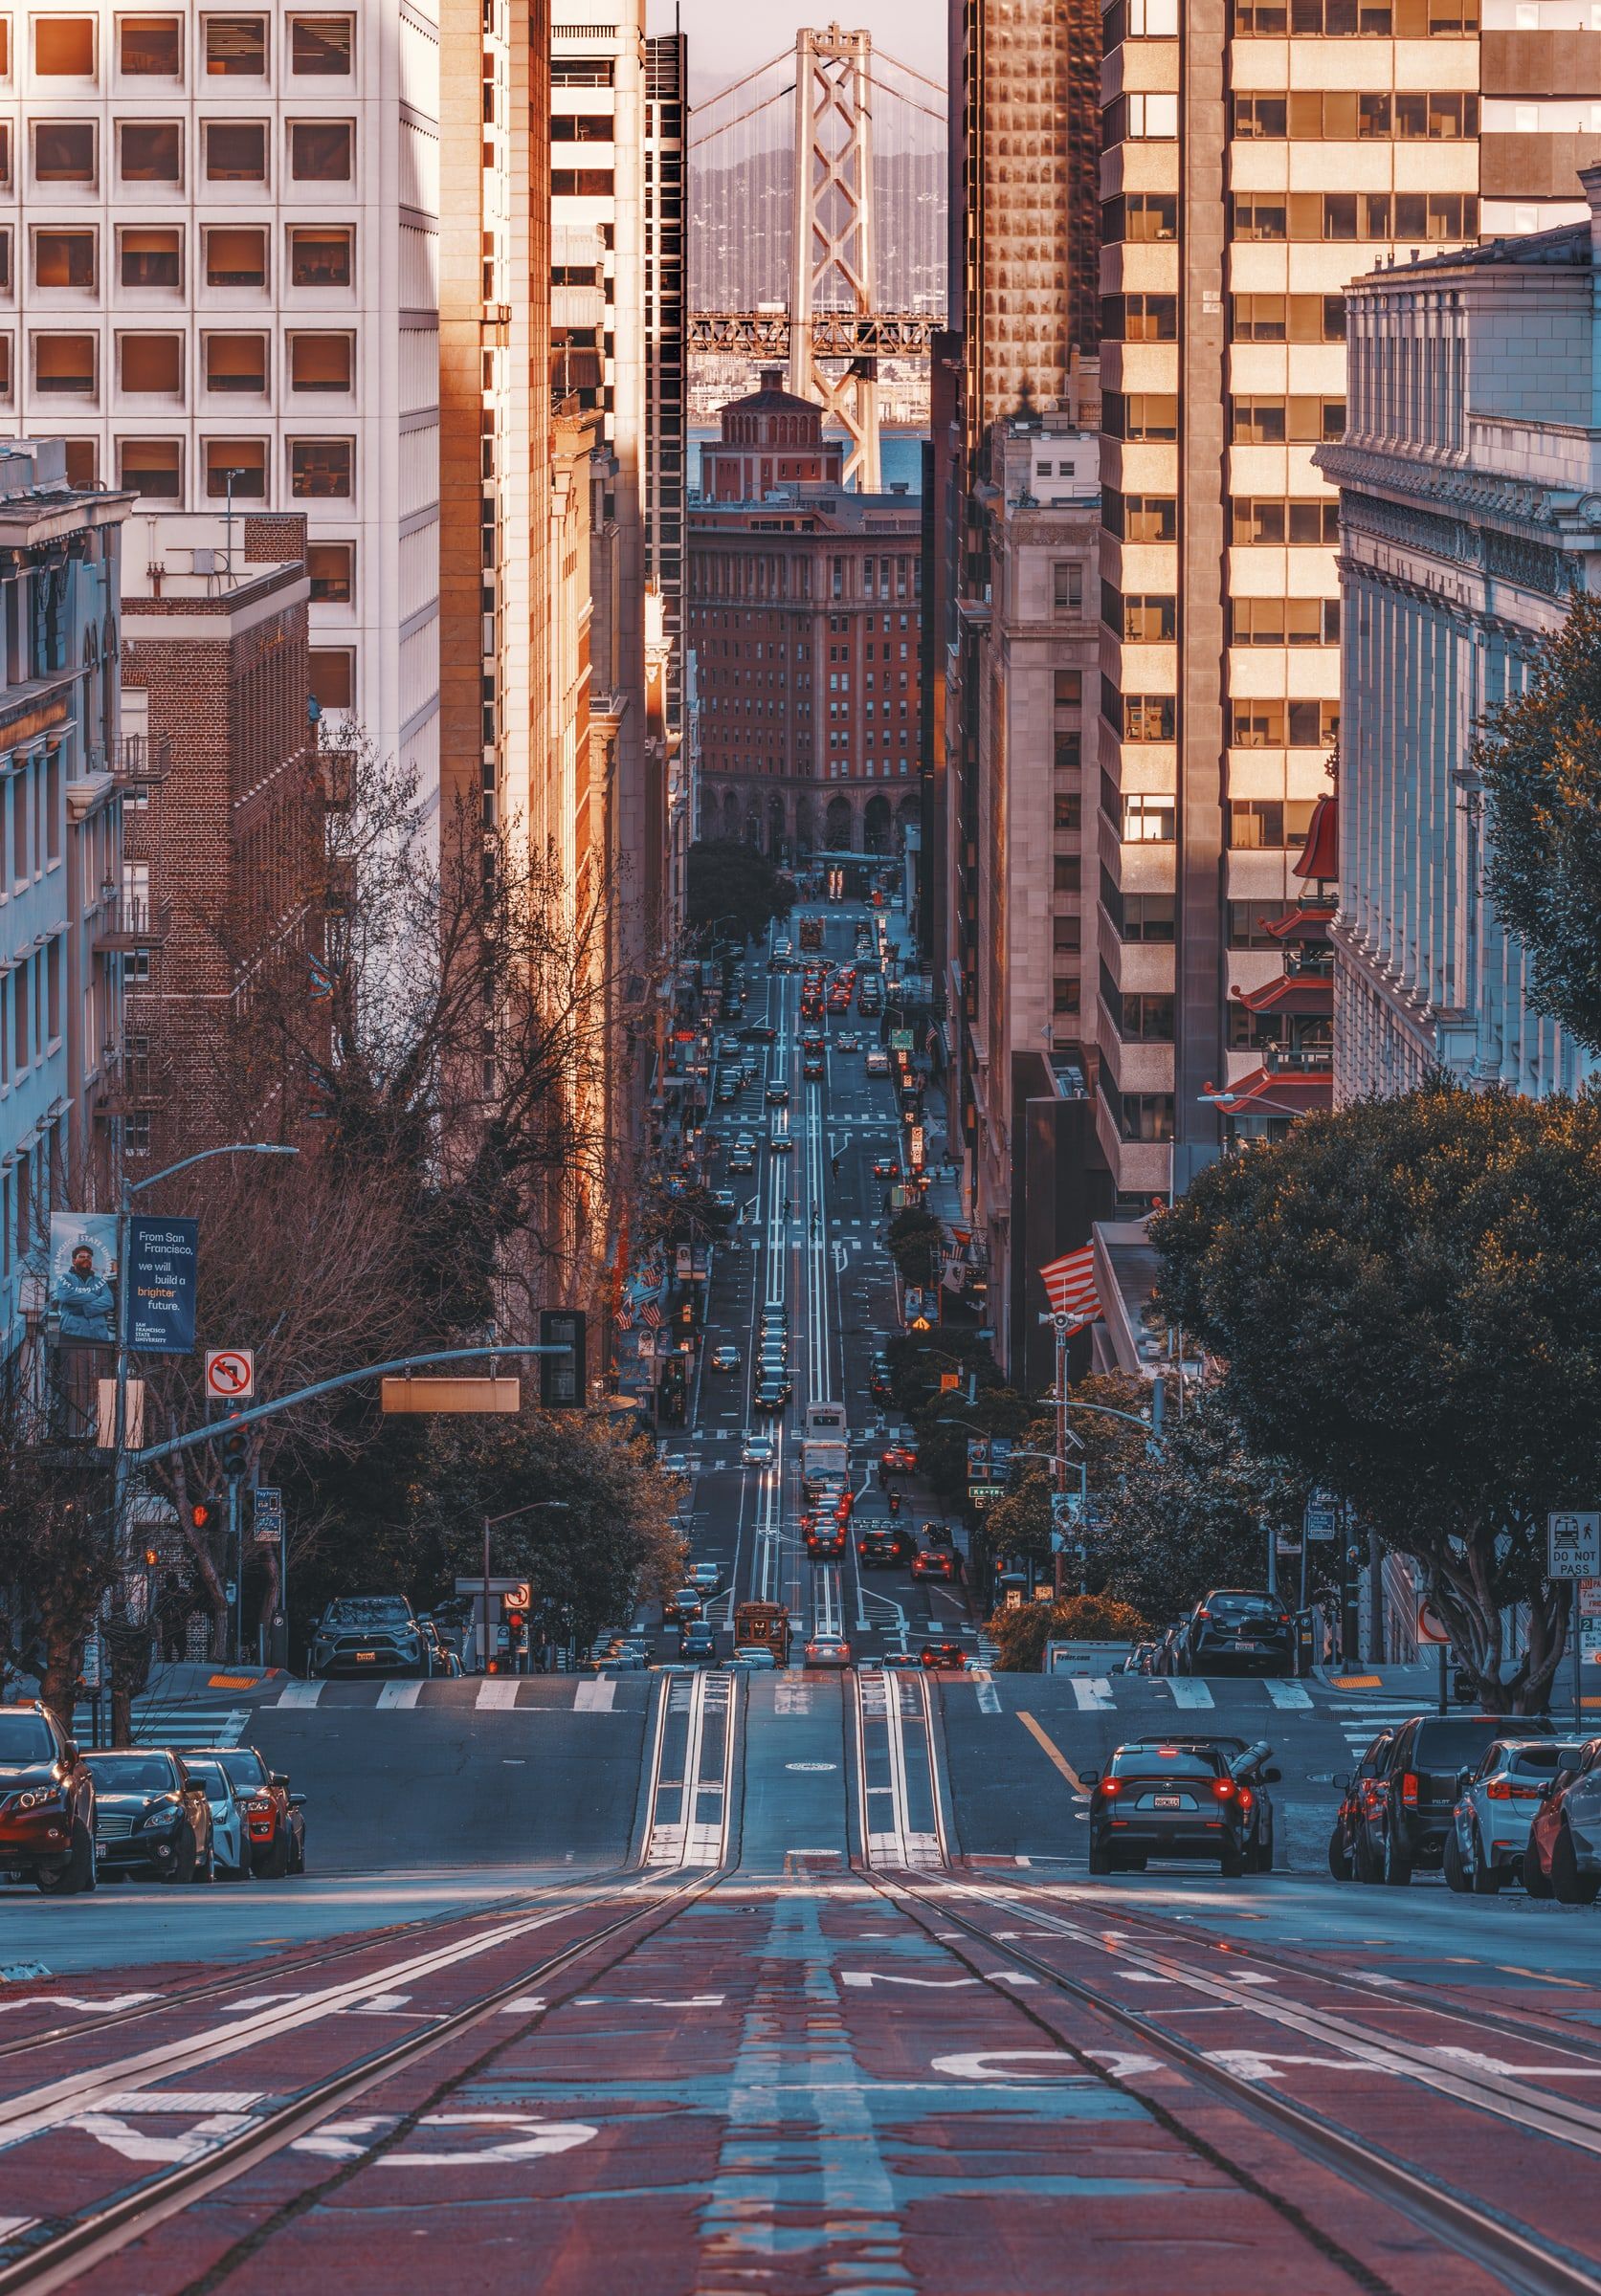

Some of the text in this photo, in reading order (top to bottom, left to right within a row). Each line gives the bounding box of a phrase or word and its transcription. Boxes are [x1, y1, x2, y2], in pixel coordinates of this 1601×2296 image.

[80, 1234, 103, 1247] STATE
[139, 1231, 185, 1244] From San
[145, 1243, 193, 1256] Francisco,
[139, 1262, 171, 1271] we will
[155, 1274, 178, 1285] build
[137, 1287, 177, 1299] brighter
[147, 1300, 181, 1311] future.
[1553, 1551, 1597, 1561] DO NOT
[1560, 1564, 1590, 1575] PASS
[1581, 1578, 1591, 1588] NO
[1583, 1620, 1590, 1630] 2
